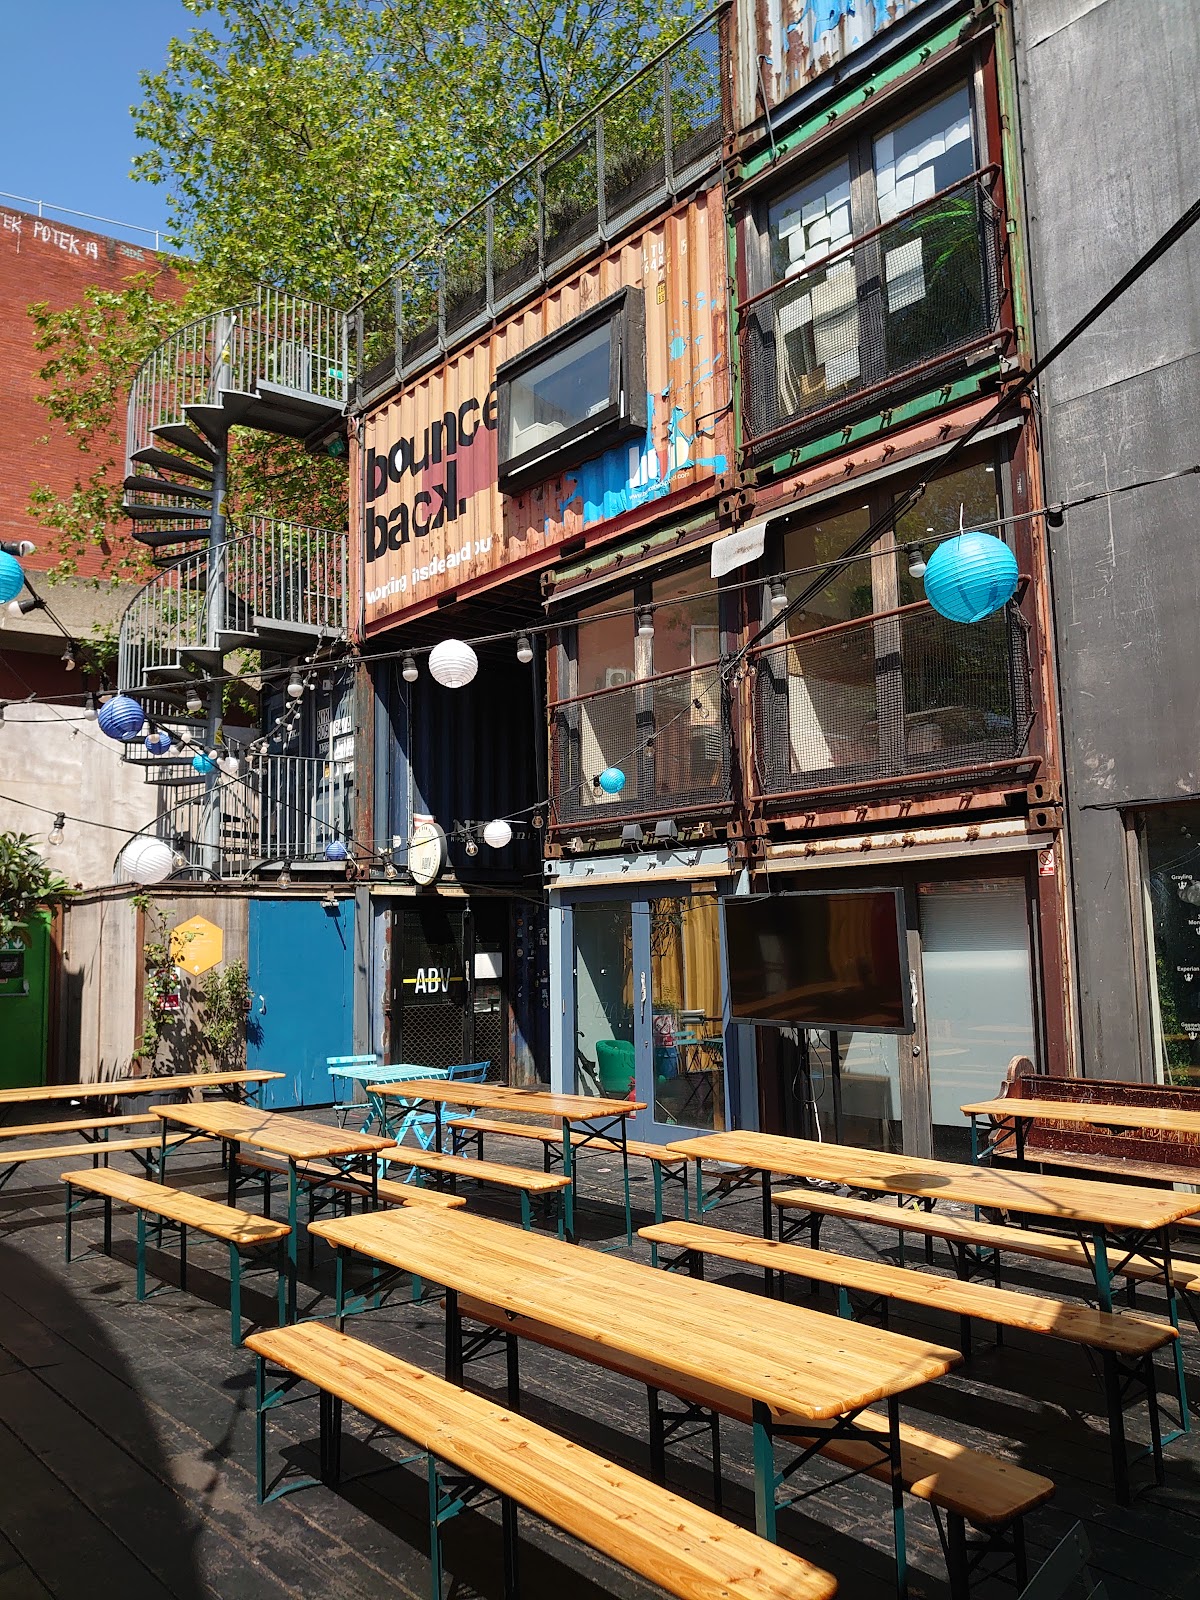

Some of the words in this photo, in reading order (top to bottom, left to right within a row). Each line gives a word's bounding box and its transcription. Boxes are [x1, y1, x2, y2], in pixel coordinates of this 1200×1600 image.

[366, 379, 498, 503] bounce
[414, 967, 451, 994] ABV
[1176, 965, 1200, 973] Experian
